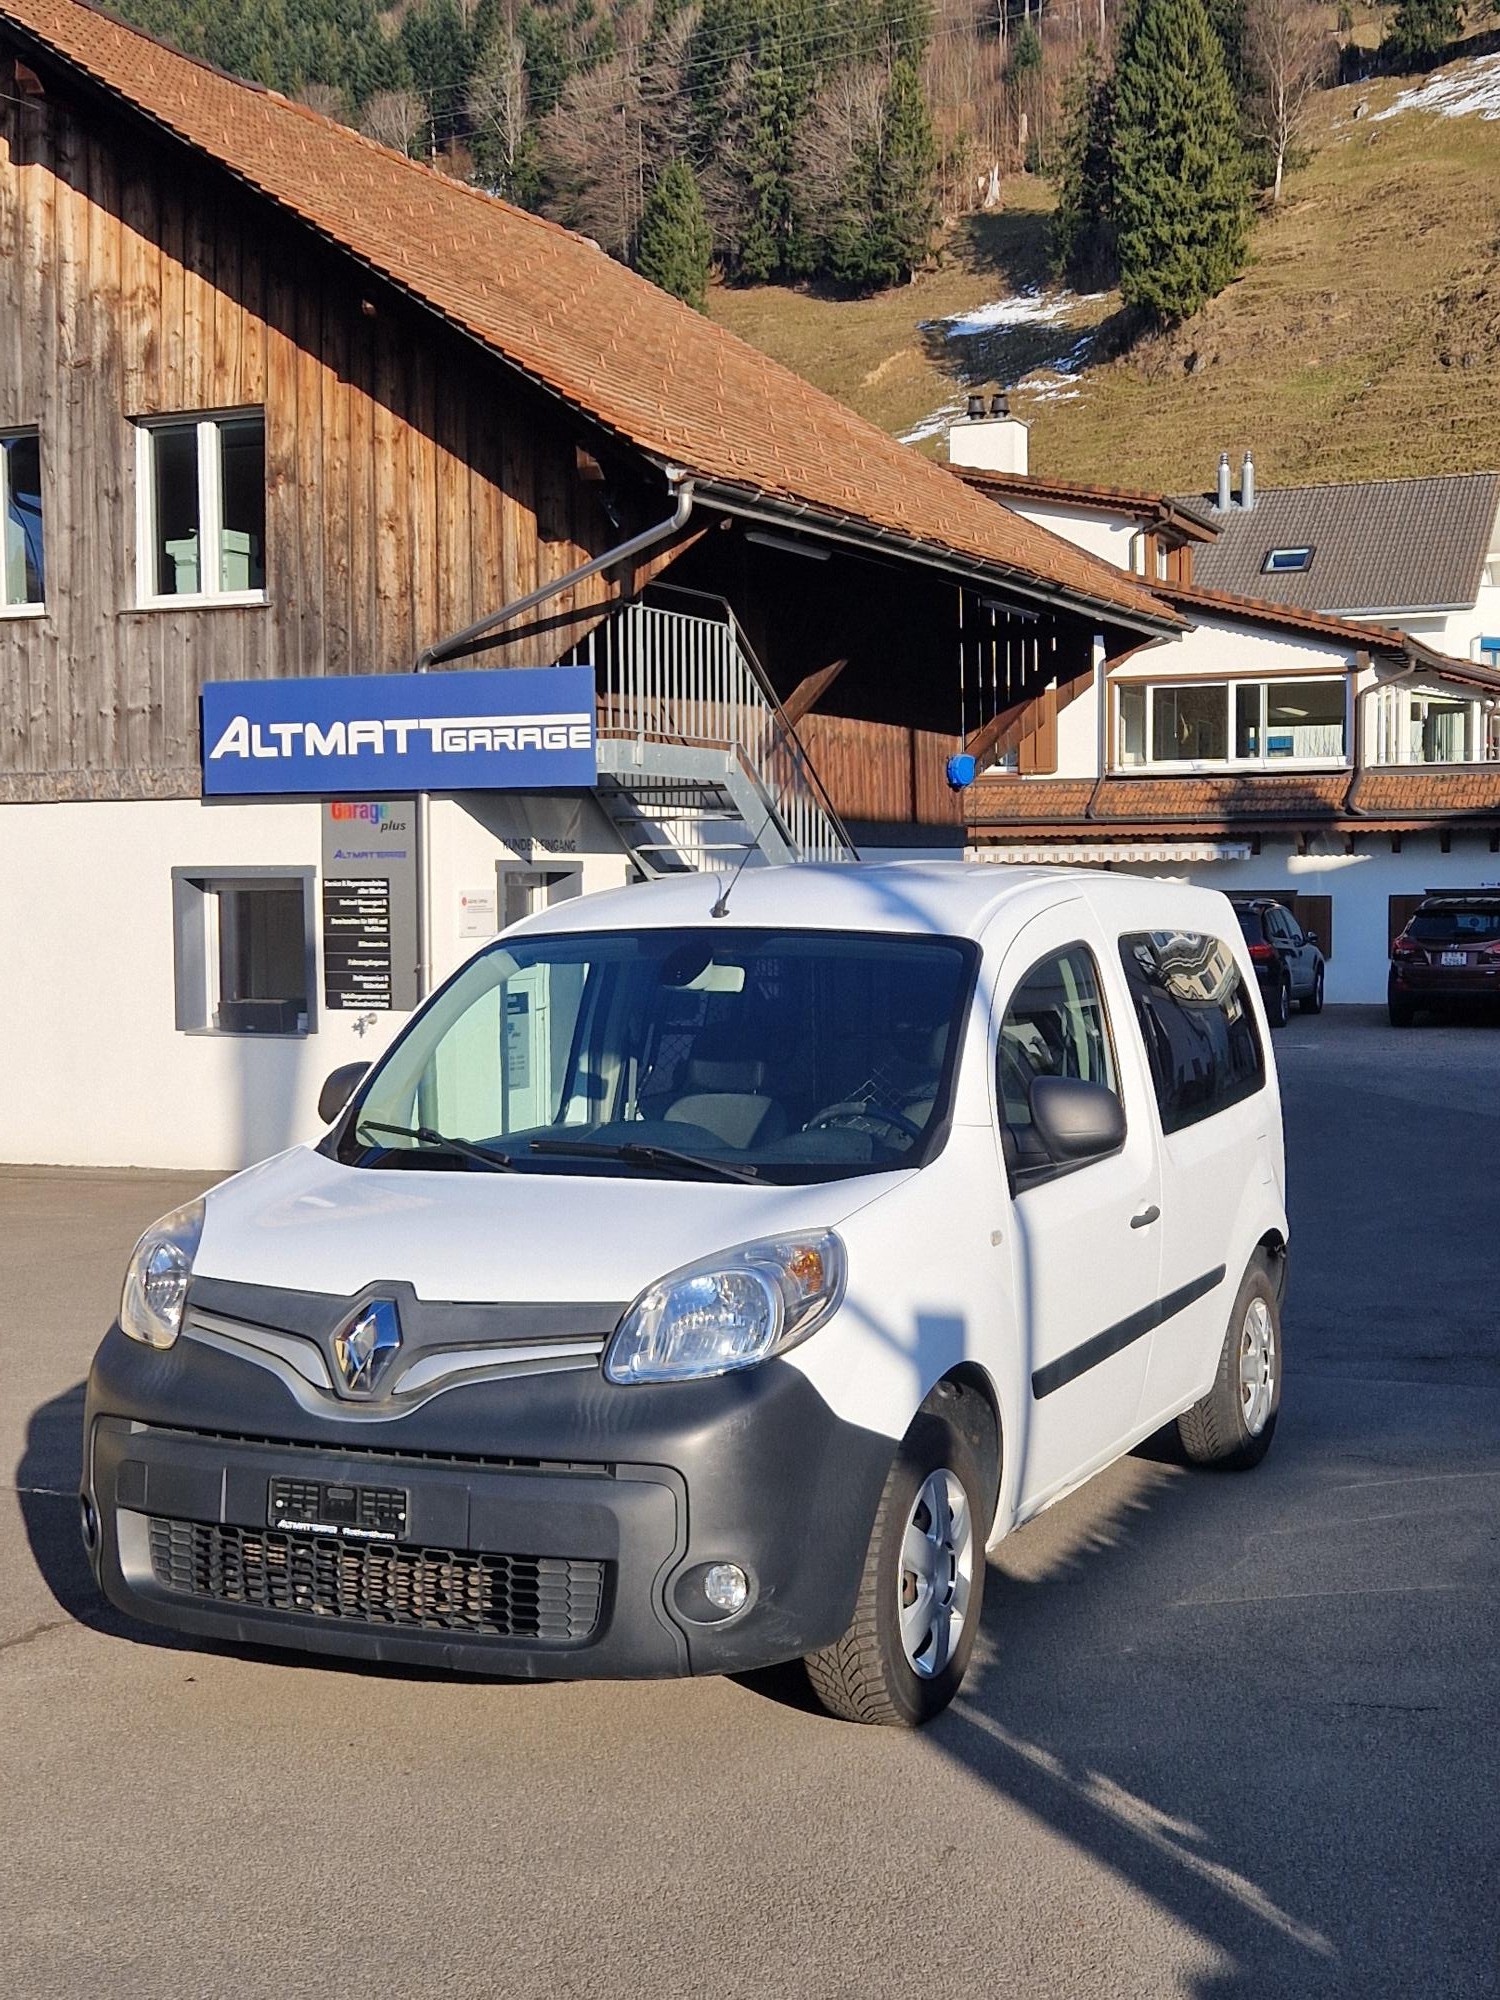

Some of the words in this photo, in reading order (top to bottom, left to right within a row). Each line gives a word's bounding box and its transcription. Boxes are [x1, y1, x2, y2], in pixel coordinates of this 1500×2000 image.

[208, 716, 447, 759] ALTMATT
[443, 726, 592, 752] GARAGE
[331, 801, 389, 825] Garage
[380, 820, 407, 833] plus
